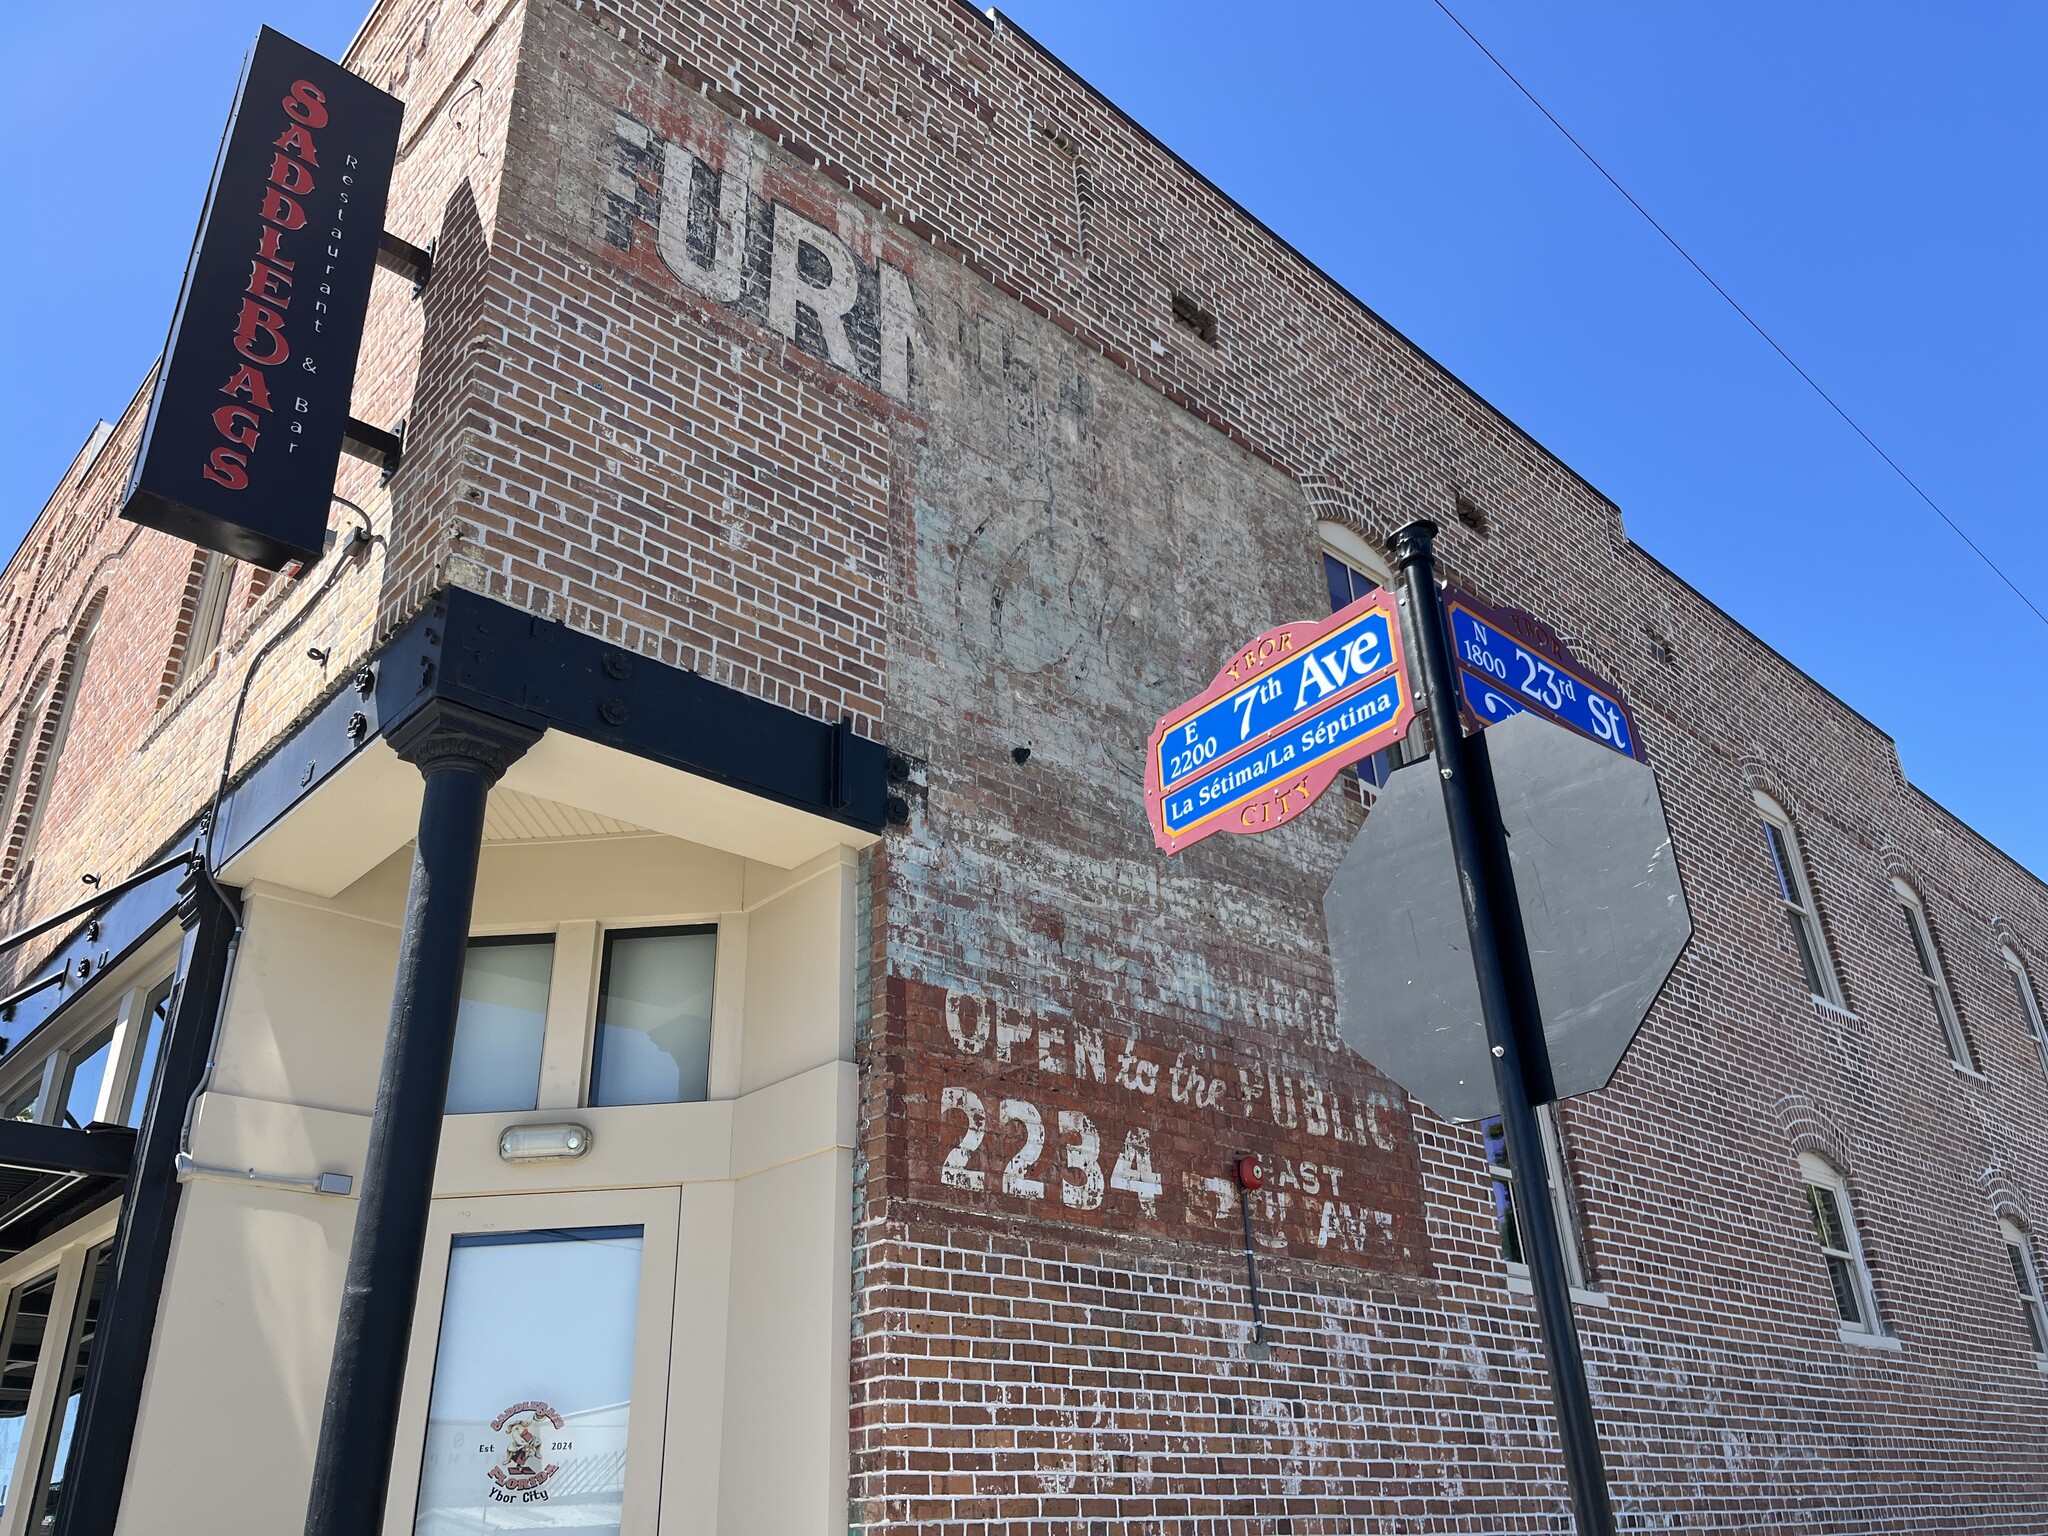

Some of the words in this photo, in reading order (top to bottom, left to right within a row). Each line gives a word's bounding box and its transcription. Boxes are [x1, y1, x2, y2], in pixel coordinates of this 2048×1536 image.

[313, 154, 358, 335] Restaurant
[203, 80, 329, 490] SADDLEBAGS
[302, 356, 317, 375] &
[288, 397, 309, 454] Bar
[1226, 631, 1293, 682] YBOR
[1472, 620, 1488, 646] N
[1509, 614, 1563, 661] YBOR
[1464, 640, 1506, 680] 1800
[1233, 677, 1283, 741] 7th
[1293, 631, 1381, 712] Ave
[1515, 648, 1576, 710] 23rd
[1587, 694, 1626, 749] St
[1170, 736, 1217, 779] 2200
[1171, 799, 1194, 821] La
[1301, 693, 1392, 752] Séptima
[1184, 720, 1199, 746] E
[1241, 775, 1312, 826] CITY
[945, 988, 1107, 1084] OPEN
[1115, 1037, 1159, 1095] to
[1168, 1046, 1228, 1110] the
[1238, 1062, 1397, 1151] PUBLIC
[940, 1087, 1163, 1219] 2234
[479, 1444, 495, 1453] Est
[551, 1442, 573, 1451] 2024
[487, 1463, 559, 1491] FLORIDA
[488, 1487, 517, 1503] Ybor
[522, 1490, 549, 1503] City
